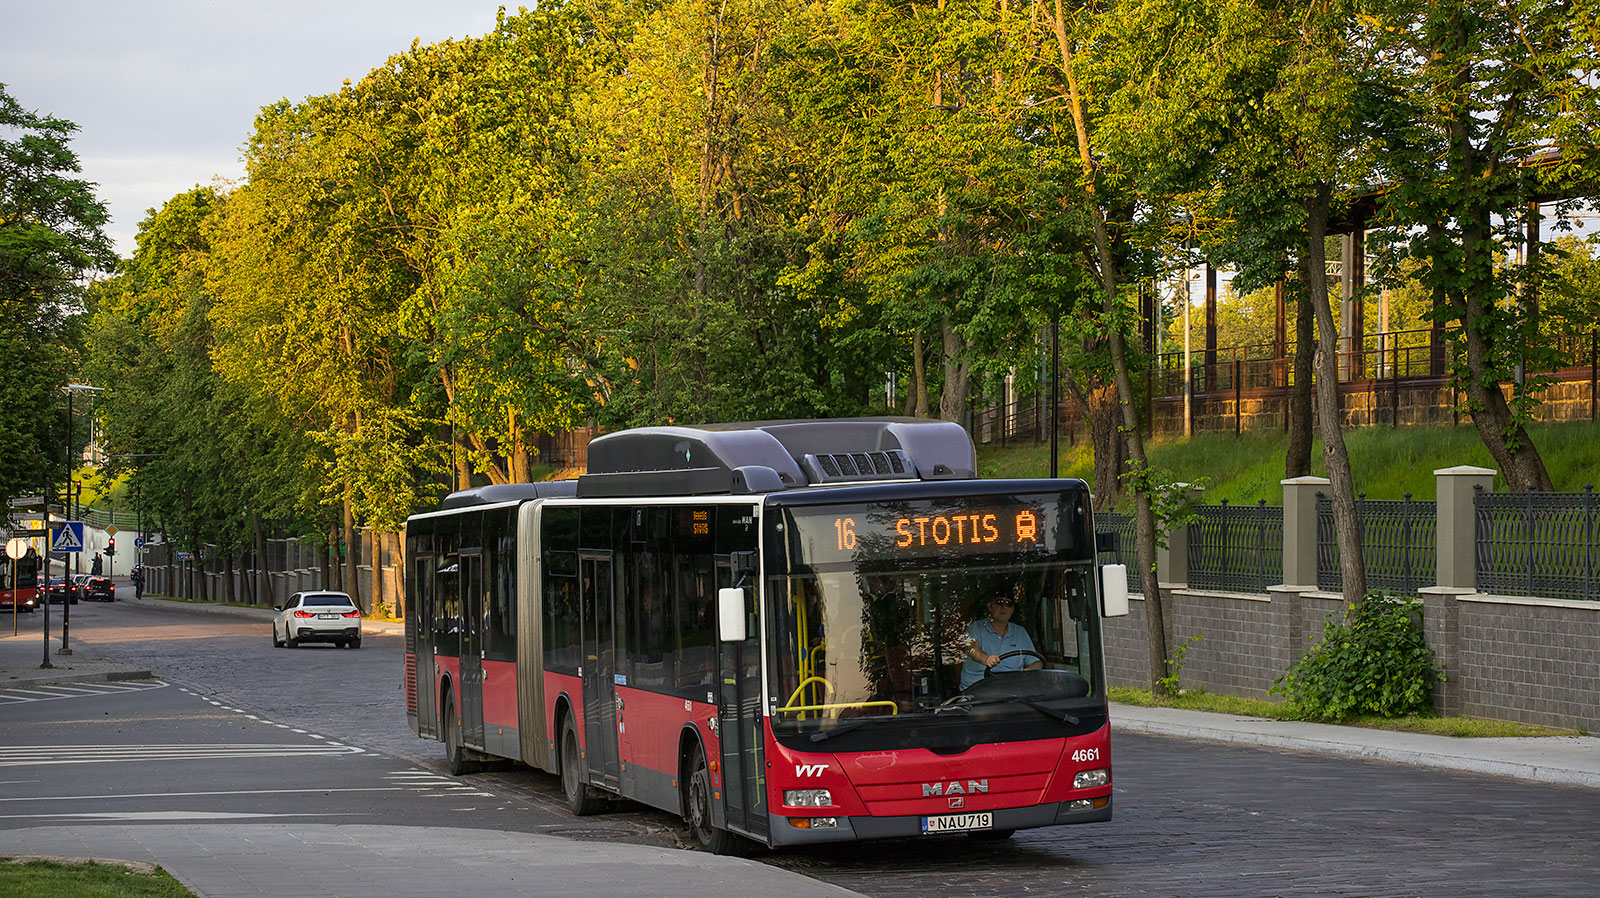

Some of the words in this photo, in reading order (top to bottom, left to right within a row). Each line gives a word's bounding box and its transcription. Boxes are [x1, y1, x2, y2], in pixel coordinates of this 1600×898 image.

[834, 517, 856, 550] 16
[896, 514, 998, 547] STOTIS
[1071, 747, 1100, 763] 4661
[795, 764, 830, 778] VVT
[922, 779, 989, 797] MAN
[938, 814, 989, 829] NAU719
